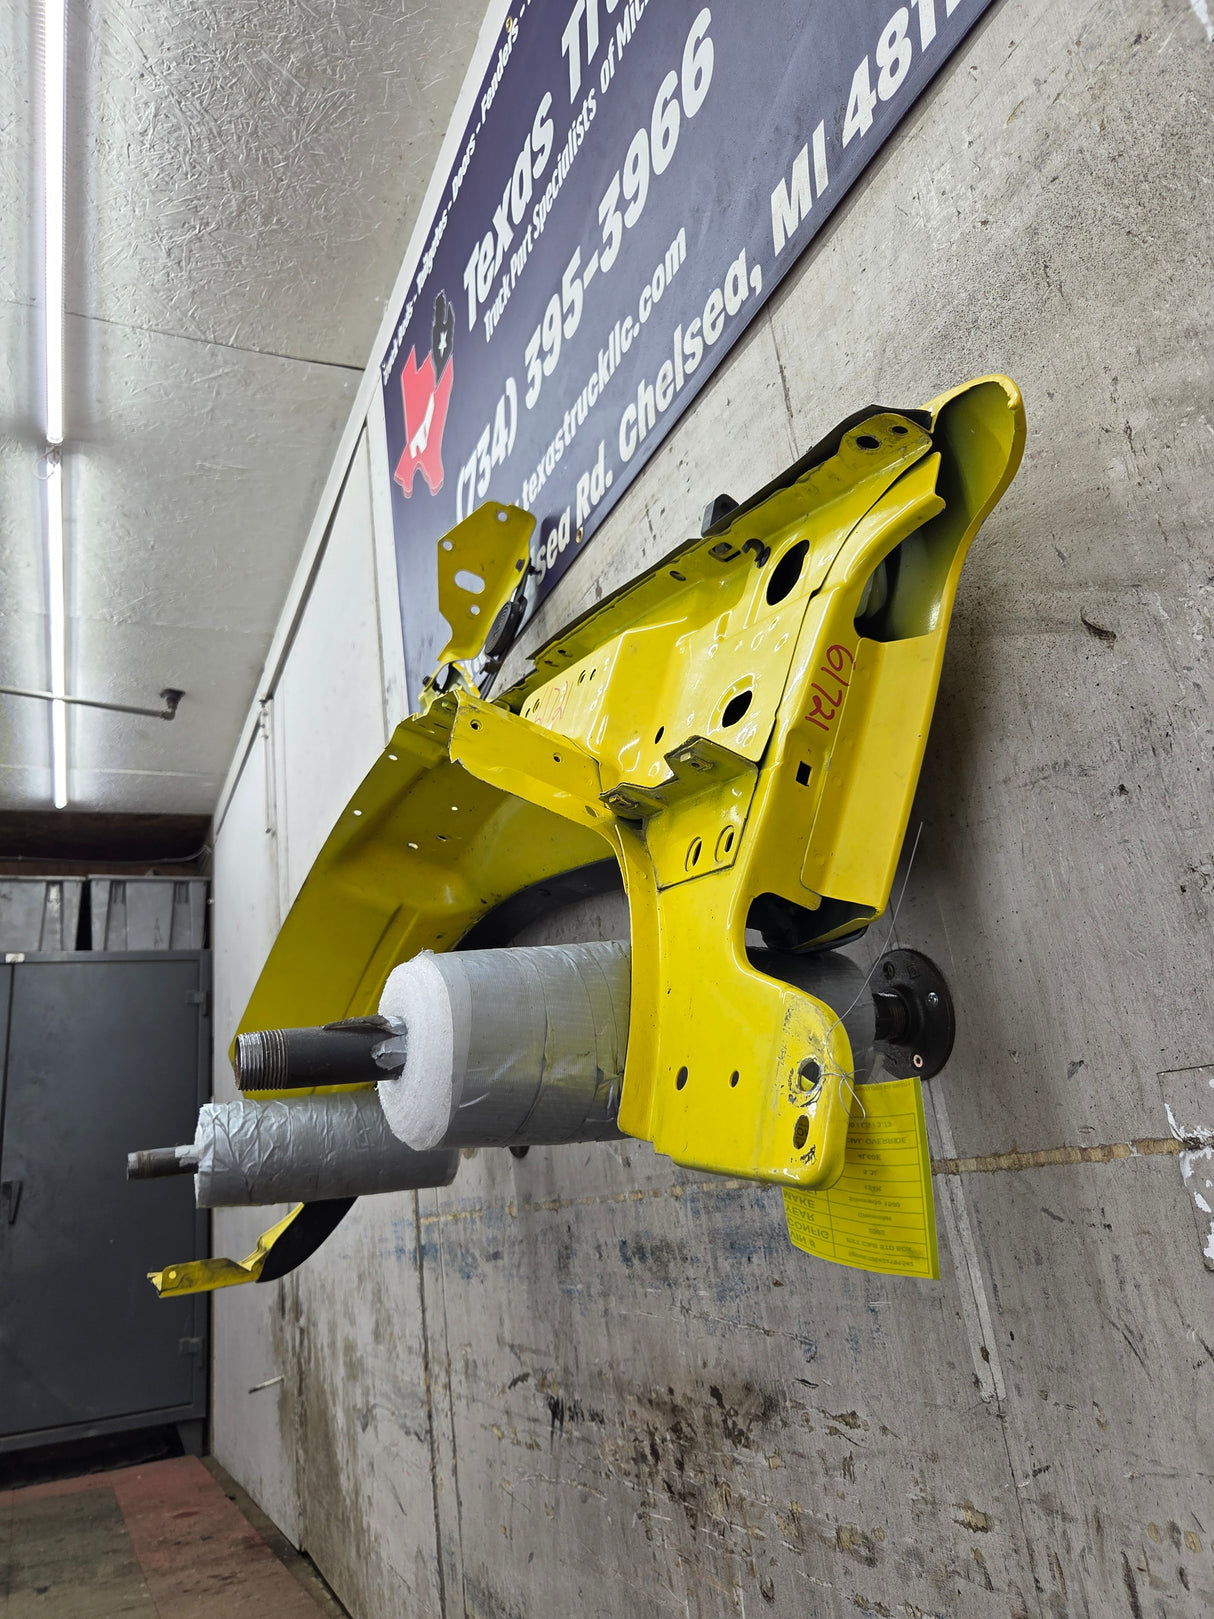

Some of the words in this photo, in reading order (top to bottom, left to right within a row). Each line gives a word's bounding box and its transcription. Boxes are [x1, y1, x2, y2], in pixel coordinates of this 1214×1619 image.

[452, 133, 475, 202] Doors
[481, 17, 519, 124] Fenders
[463, 91, 554, 332] Texas
[484, 273, 511, 343] Truck
[510, 224, 533, 289] Part
[532, 88, 596, 239] Specialists
[456, 376, 518, 524] (734)
[524, 7, 715, 410] 395-3966
[514, 227, 687, 511] texastruckllc.com
[535, 505, 571, 586] sea
[576, 439, 614, 530] Rd.
[618, 247, 763, 463] Chelsea,
[771, 119, 829, 257] MI
[842, 0, 960, 149] 481
[804, 644, 856, 731] 61721
